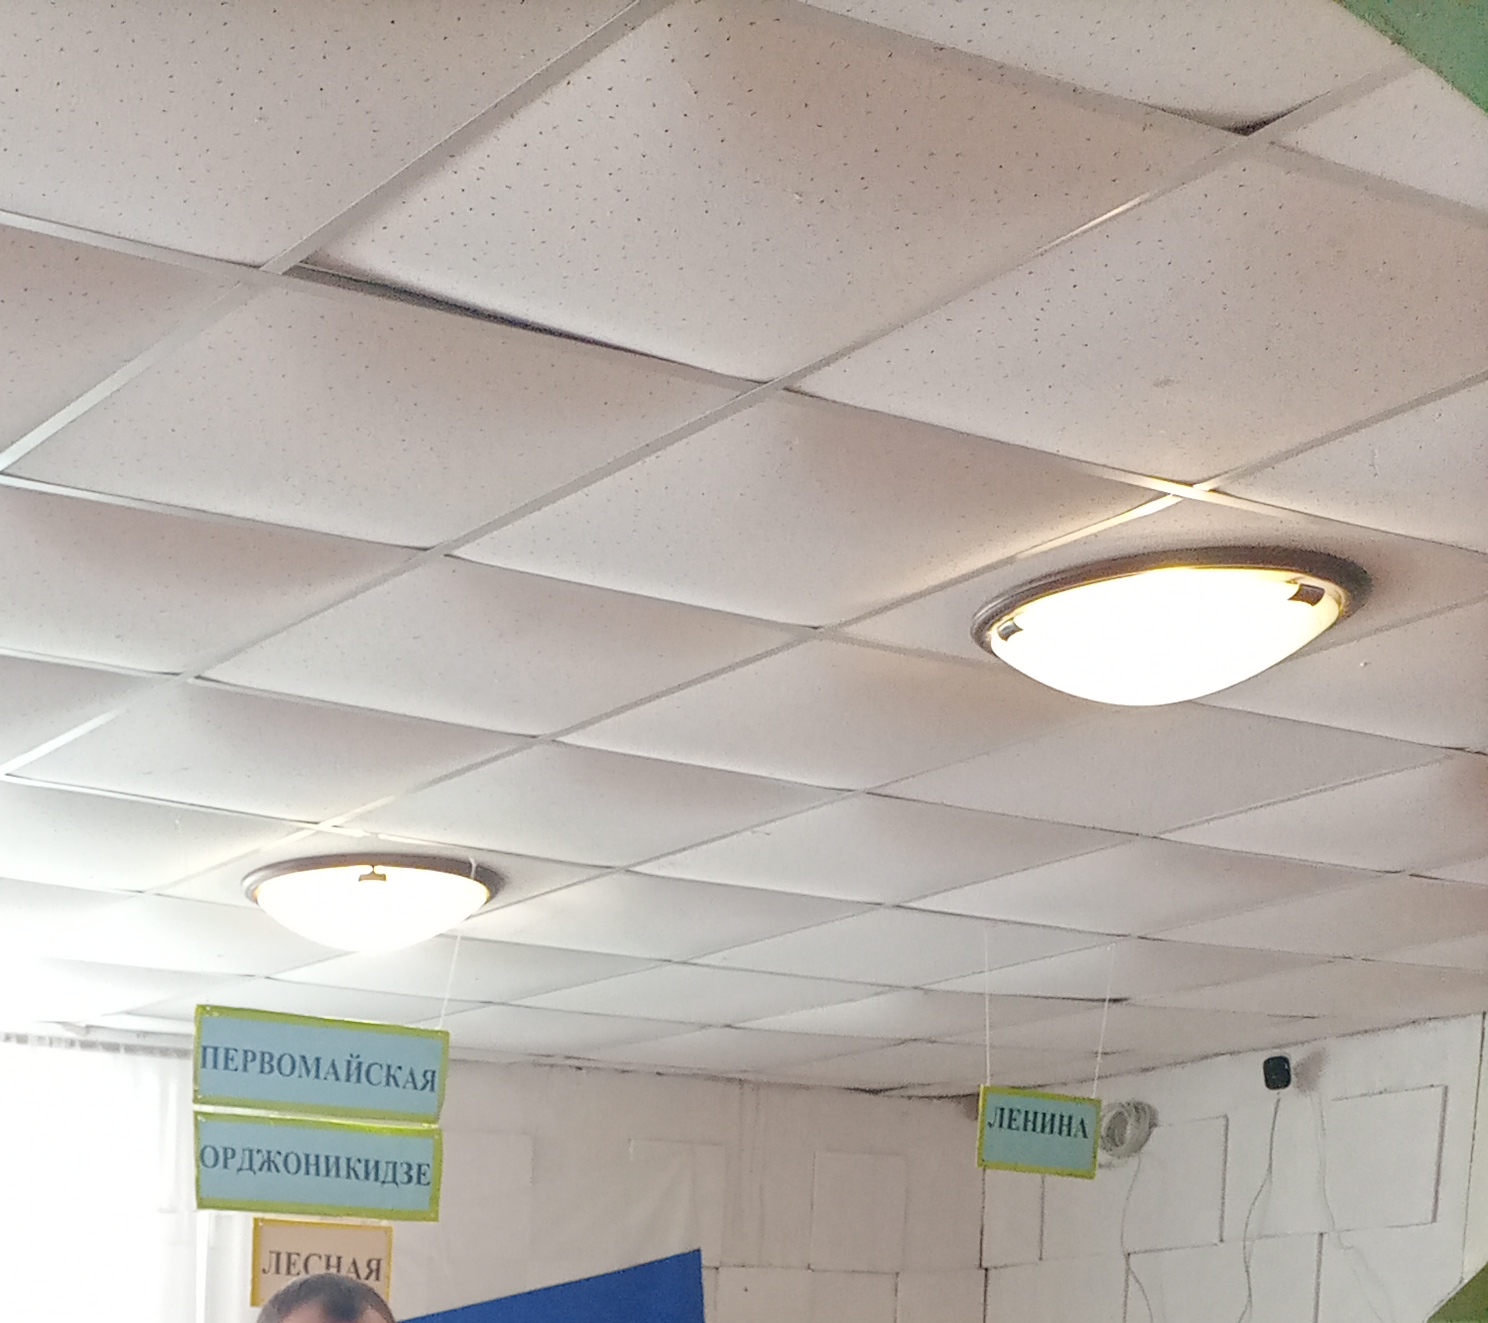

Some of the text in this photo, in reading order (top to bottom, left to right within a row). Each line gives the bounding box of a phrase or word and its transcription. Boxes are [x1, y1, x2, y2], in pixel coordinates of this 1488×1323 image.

[200, 1044, 438, 1093] ПЕРВОМАЙСКАЯ
[987, 1106, 1089, 1139] ЛЕНИНА
[198, 1144, 432, 1188] ОРДЖОНИКИДЗЕ
[261, 1250, 383, 1282] ЛЕСНАЯ
